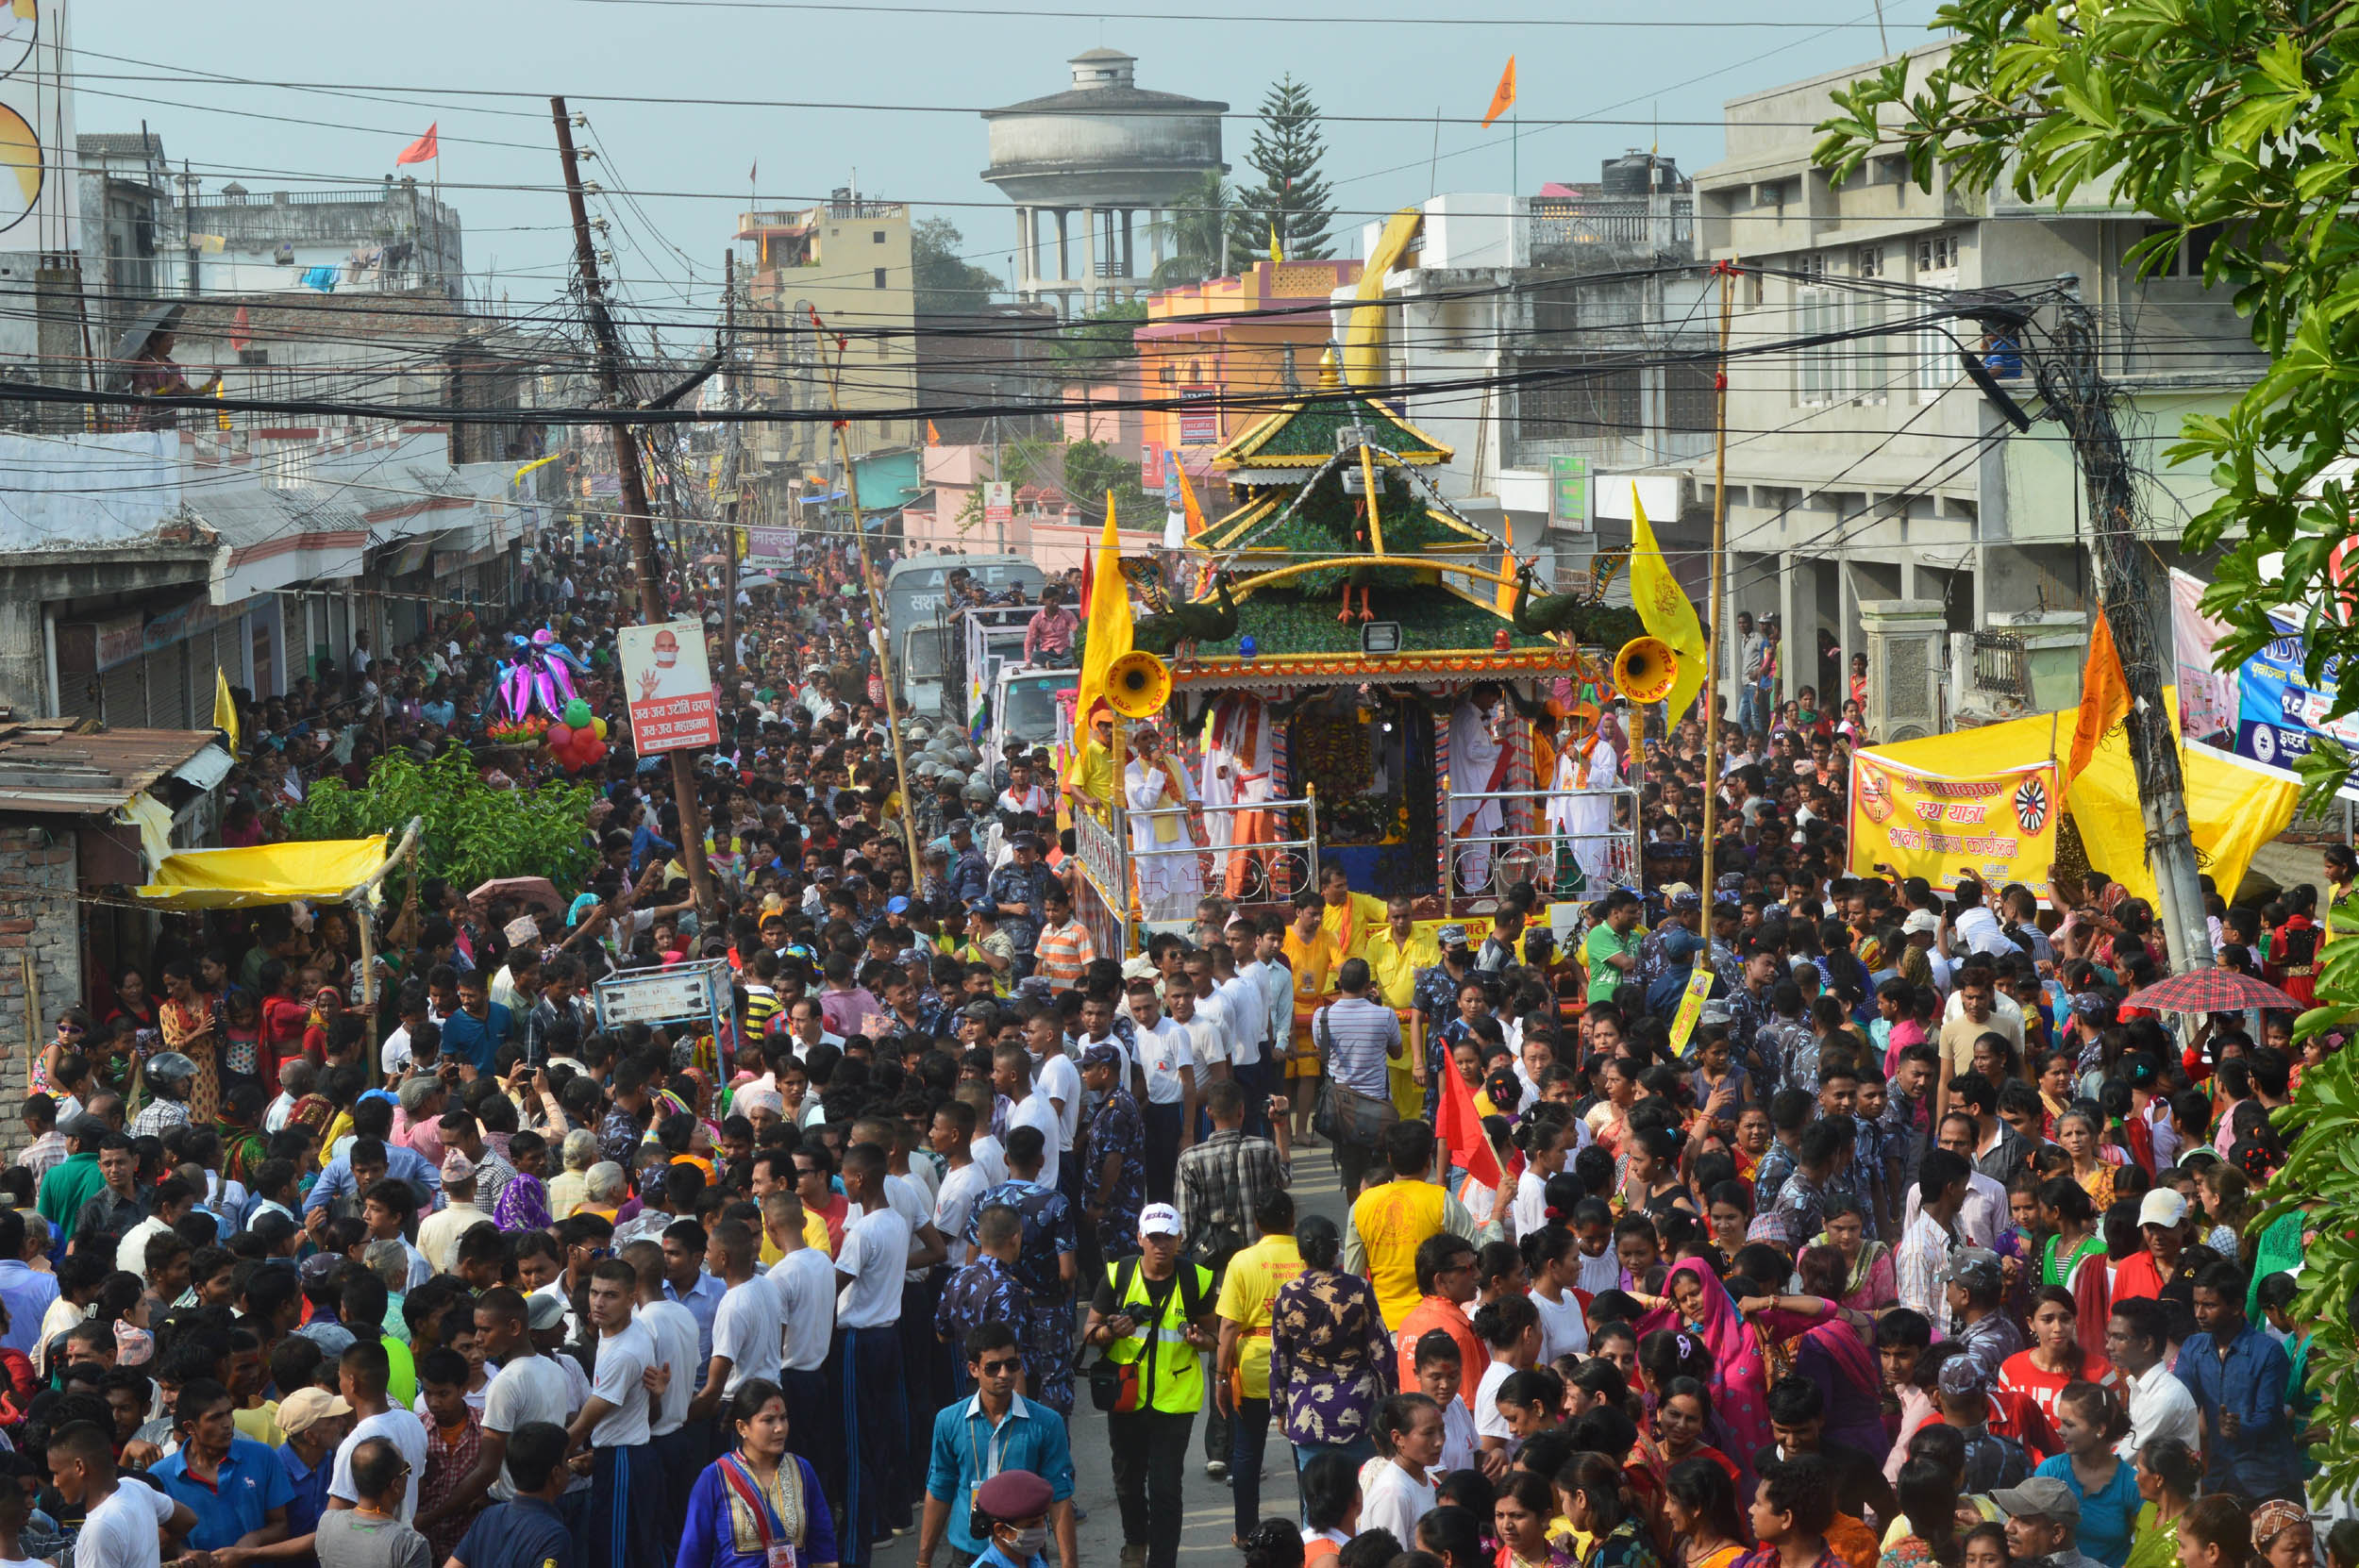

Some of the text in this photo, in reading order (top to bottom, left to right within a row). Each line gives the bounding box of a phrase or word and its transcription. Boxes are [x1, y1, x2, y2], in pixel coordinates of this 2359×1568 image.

[634, 706, 665, 720] जय-जय
[642, 723, 672, 737] जय-जय
[1899, 775, 2002, 802] श्री राधाकृष्ण
[1916, 801, 1987, 824] रथ यात्रा
[1964, 830, 2018, 858] कार्यक्रम
